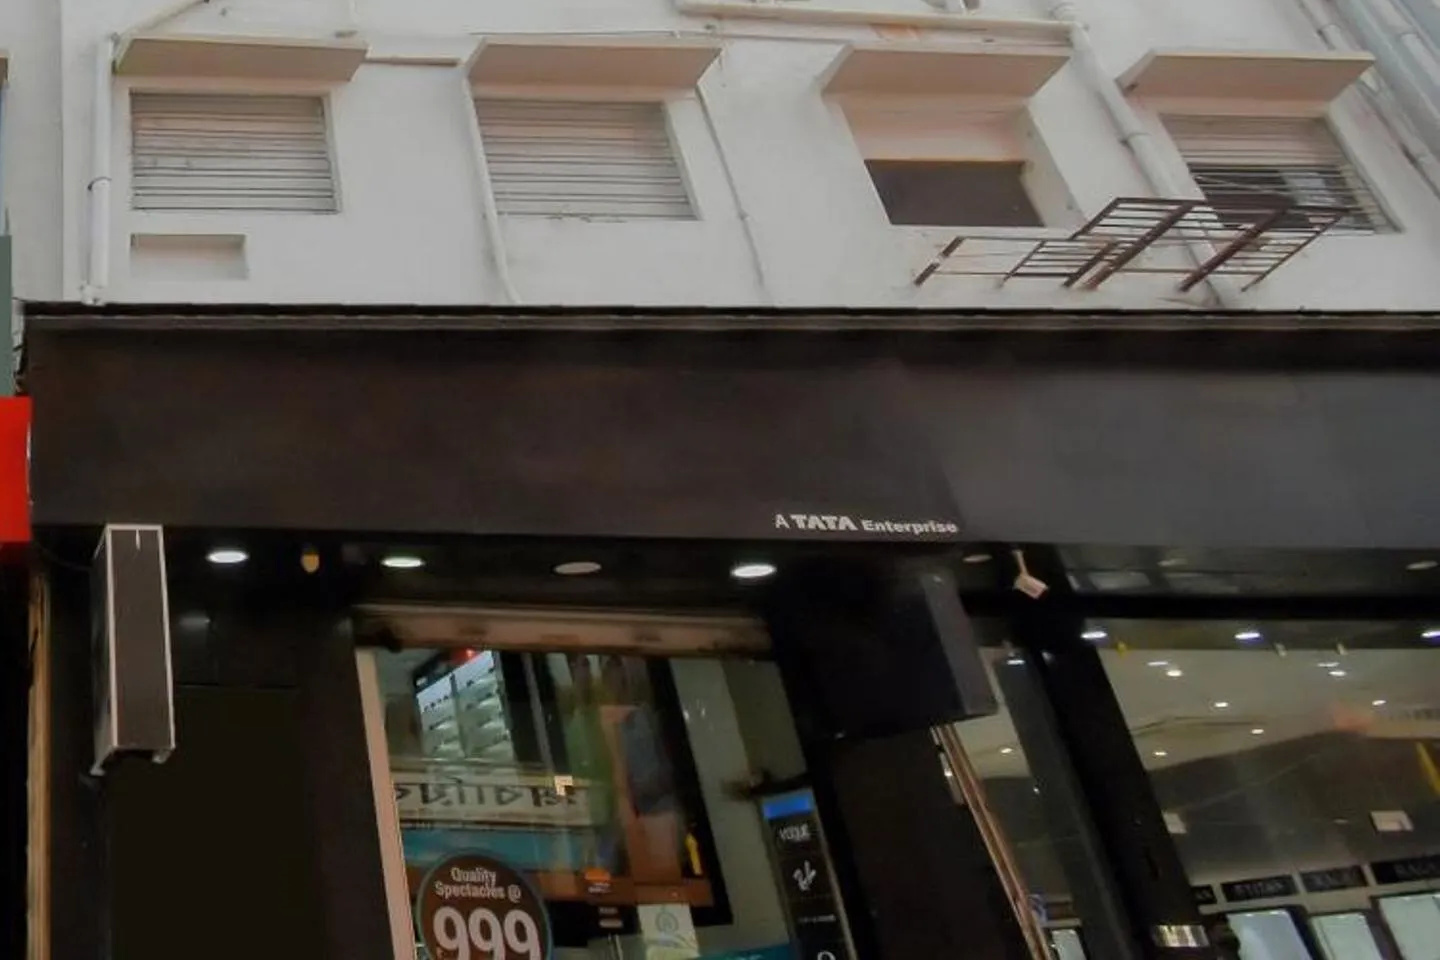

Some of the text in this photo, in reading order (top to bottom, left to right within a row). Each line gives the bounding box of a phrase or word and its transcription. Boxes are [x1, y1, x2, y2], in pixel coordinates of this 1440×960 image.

[775, 513, 958, 535] A TATA Enterprise
[450, 866, 497, 888] Quality
[434, 880, 506, 900] Spectacles
[433, 905, 543, 960] 999
